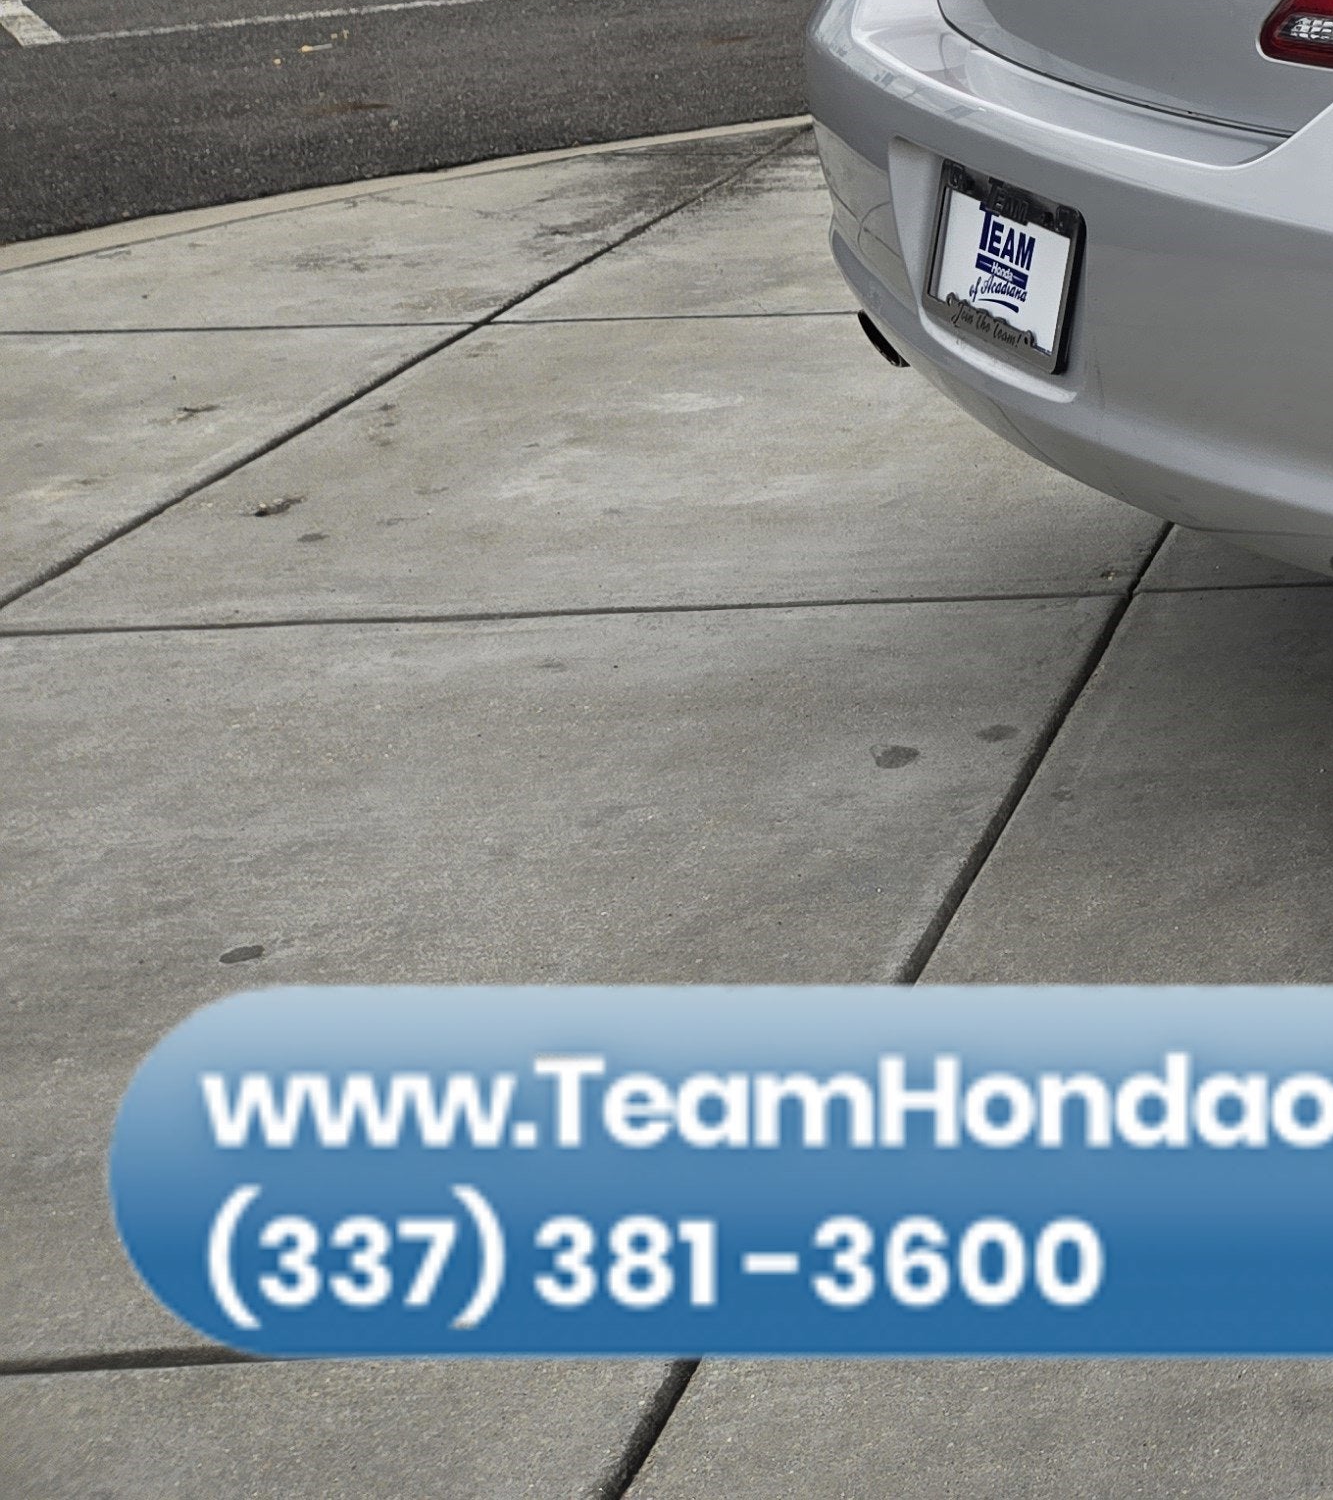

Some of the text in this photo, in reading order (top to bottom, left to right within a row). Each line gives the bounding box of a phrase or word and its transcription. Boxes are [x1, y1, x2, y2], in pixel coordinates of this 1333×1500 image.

[979, 201, 1036, 271] TEAM
[991, 261, 1014, 282] Honda
[969, 276, 982, 302] of
